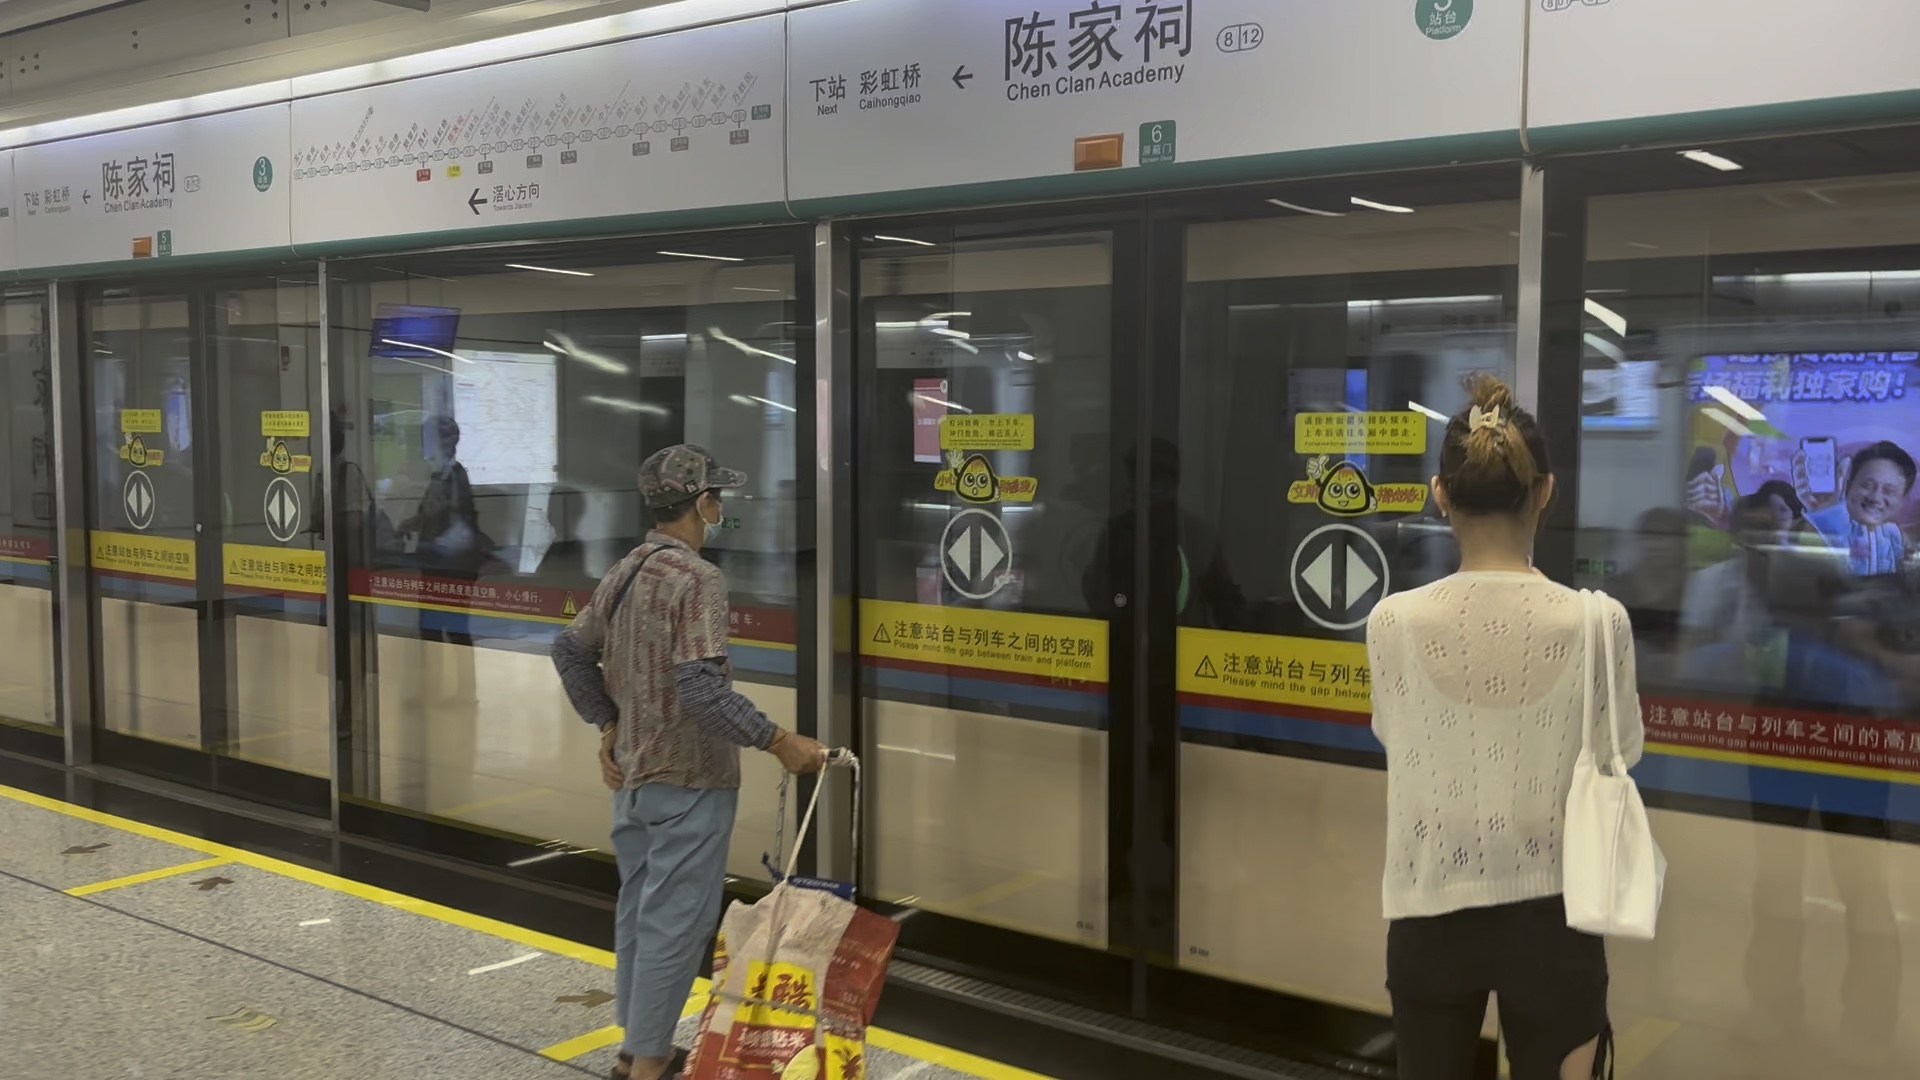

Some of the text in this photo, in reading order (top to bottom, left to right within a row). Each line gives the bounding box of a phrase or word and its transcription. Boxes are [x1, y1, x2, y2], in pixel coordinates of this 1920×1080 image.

[1429, 10, 1457, 26] 站台
[1005, 0, 1192, 81] 陈家祠
[1224, 29, 1259, 47] 8 12
[1425, 24, 1461, 36] Platform
[809, 62, 922, 102] 下站 彩虹桥
[1006, 64, 1185, 101] Chen Clan Academy
[817, 93, 922, 116] Next Caihongqiao
[1152, 124, 1162, 143] 6
[102, 152, 175, 201] 陈家祠
[259, 158, 266, 175] 3
[104, 202, 123, 213] Chen
[141, 197, 173, 209] Academy
[161, 232, 167, 243] 5
[893, 620, 1094, 657] 注意站台与列车之间的空隙
[894, 639, 1091, 669] Please mind the gap between train and platform
[1223, 674, 1256, 688] Please
[1261, 680, 1285, 690] mind
[1290, 683, 1306, 693] the
[1311, 686, 1330, 697] gap
[1681, 731, 1706, 743] mind
[1709, 734, 1724, 744] the
[1728, 737, 1746, 748] gap
[1749, 739, 1769, 750] and
[1772, 741, 1806, 755] height
[1809, 746, 1866, 760] difference
[1869, 752, 1919, 767] between
